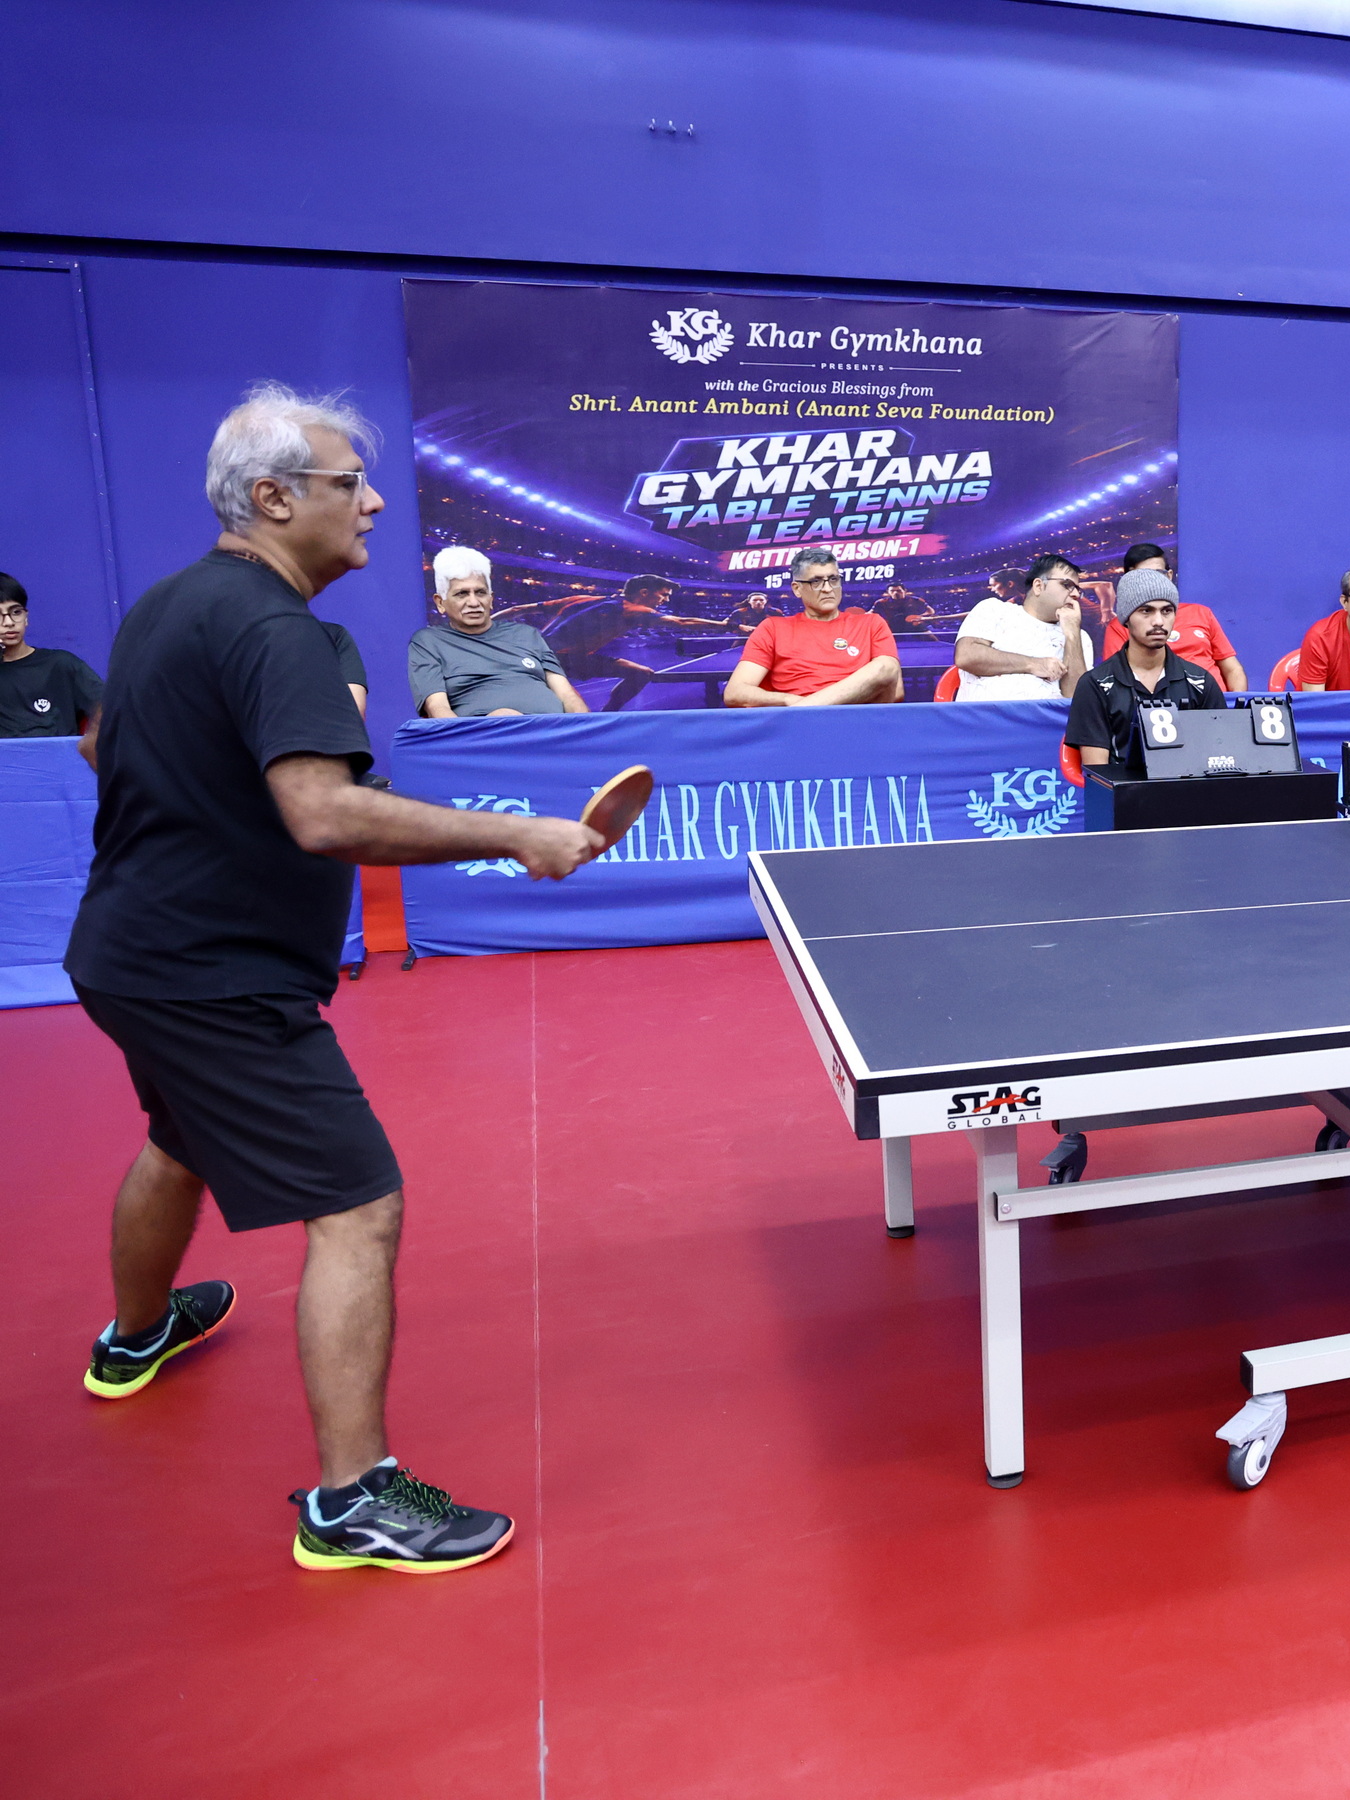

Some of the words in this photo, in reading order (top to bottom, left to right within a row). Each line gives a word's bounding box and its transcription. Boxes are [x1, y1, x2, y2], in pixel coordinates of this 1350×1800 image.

[666, 308, 722, 341] KG
[746, 322, 822, 349] Khar
[830, 326, 983, 357] Gymkhana
[820, 362, 885, 372] PRESENTS
[704, 379, 735, 392] with
[738, 380, 759, 392] the
[762, 379, 827, 393] Gracious
[831, 381, 897, 399] Blessings
[897, 383, 934, 399] from
[569, 394, 622, 412] Shri.
[628, 395, 699, 413] Anant
[703, 397, 790, 416] Ambani
[796, 399, 870, 418] (Anant
[875, 402, 924, 419] Seva
[929, 403, 1055, 425] Foundation)
[716, 429, 897, 469] KHAR
[638, 450, 993, 506] GYMKHANA
[662, 494, 816, 529] TABLE
[828, 480, 991, 515] TENNIS
[745, 509, 929, 546] LEAGUE
[856, 564, 894, 581] 2026
[1150, 709, 1177, 743] 8
[1260, 706, 1286, 740] 8
[990, 767, 1061, 809] KG
[713, 774, 935, 860] GYMKHANA
[947, 1086, 1041, 1115] STAG
[947, 1112, 1041, 1129] GLOBAL
